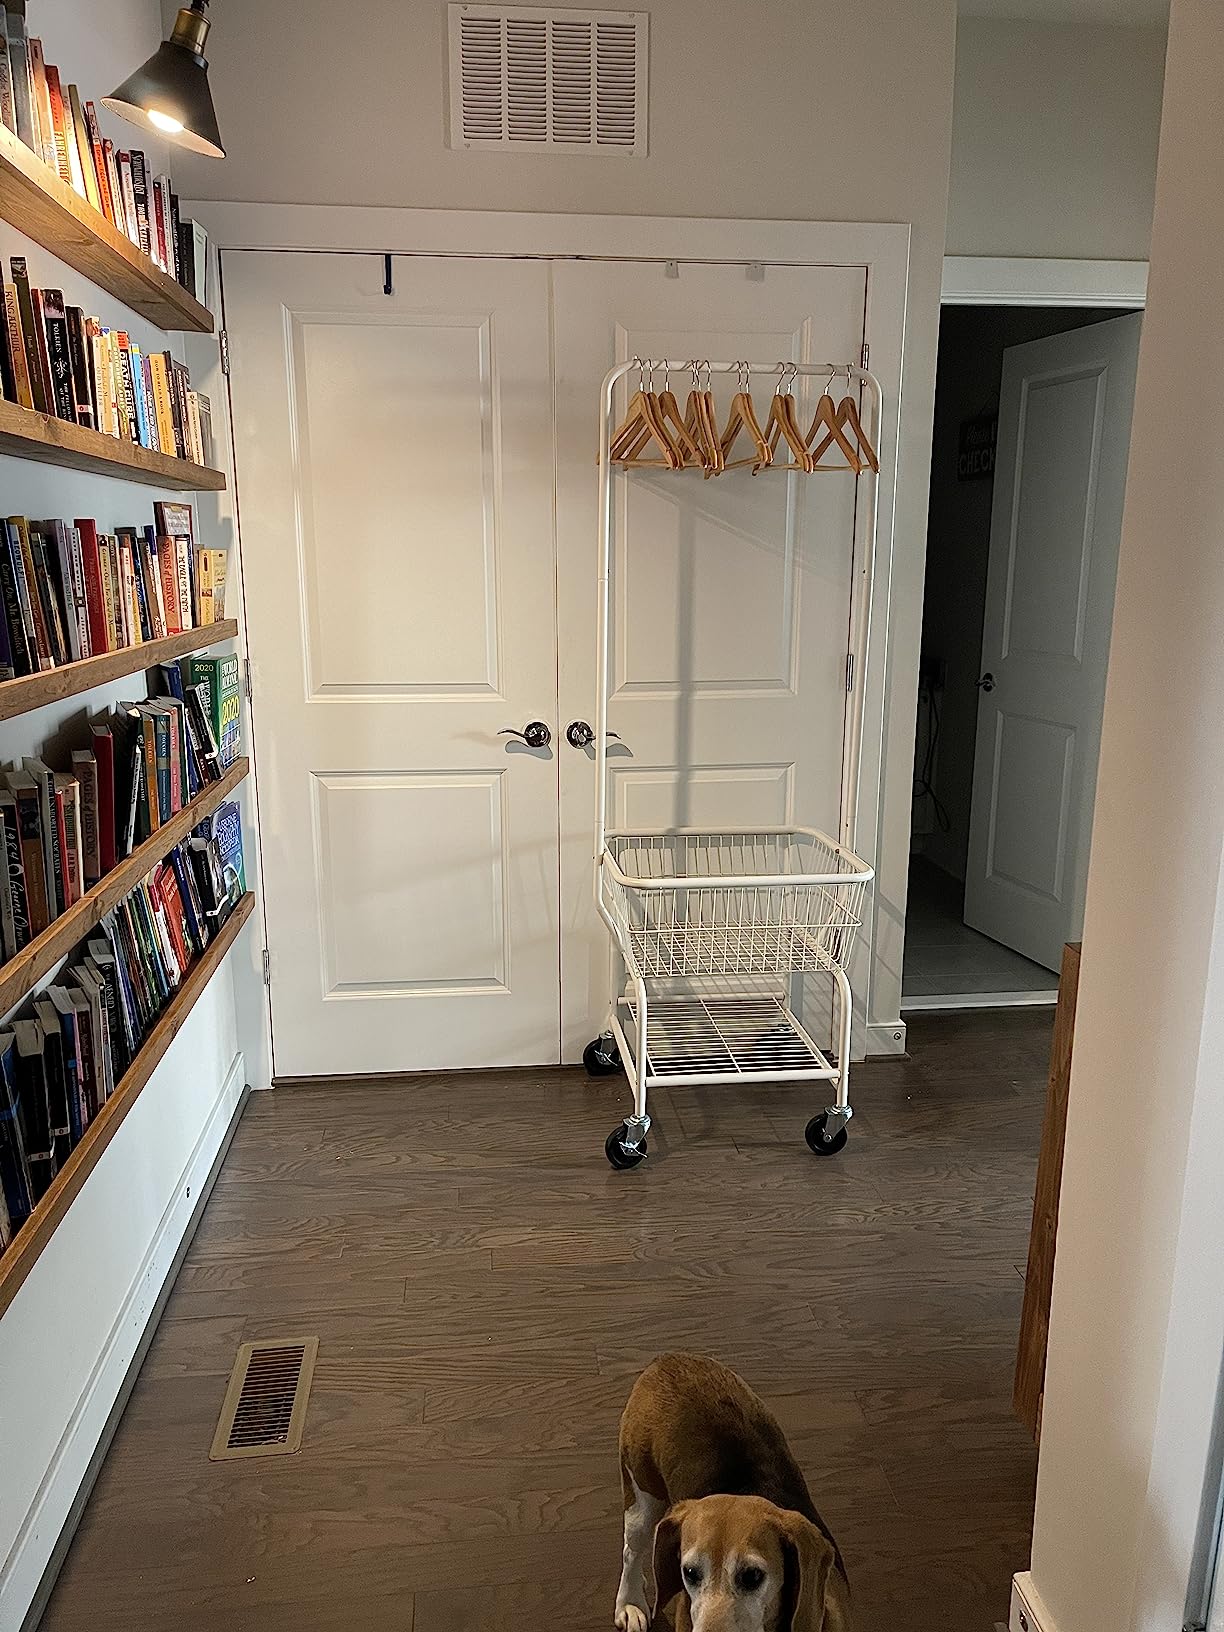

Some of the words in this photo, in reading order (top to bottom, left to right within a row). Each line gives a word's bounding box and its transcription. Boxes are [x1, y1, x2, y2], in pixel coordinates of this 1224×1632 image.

[53, 131, 70, 179] FAHRENHEIT
[4, 290, 15, 313] KING
[7, 314, 21, 352] ARTHUR
[52, 322, 62, 353] TOLKIEN
[119, 350, 130, 387] DEATH
[124, 389, 134, 419] CURE
[161, 542, 171, 570] PAGES
[3, 563, 12, 585] Carry
[8, 602, 18, 617] Mr.
[164, 577, 175, 614] HISTORY
[10, 618, 23, 654] Bowditch
[194, 664, 214, 672] 2020
[222, 694, 240, 726] 2020
[81, 769, 93, 803] PAGES
[3, 825, 19, 860] 1984
[84, 812, 96, 857] HISTORY
[8, 879, 26, 913] George
